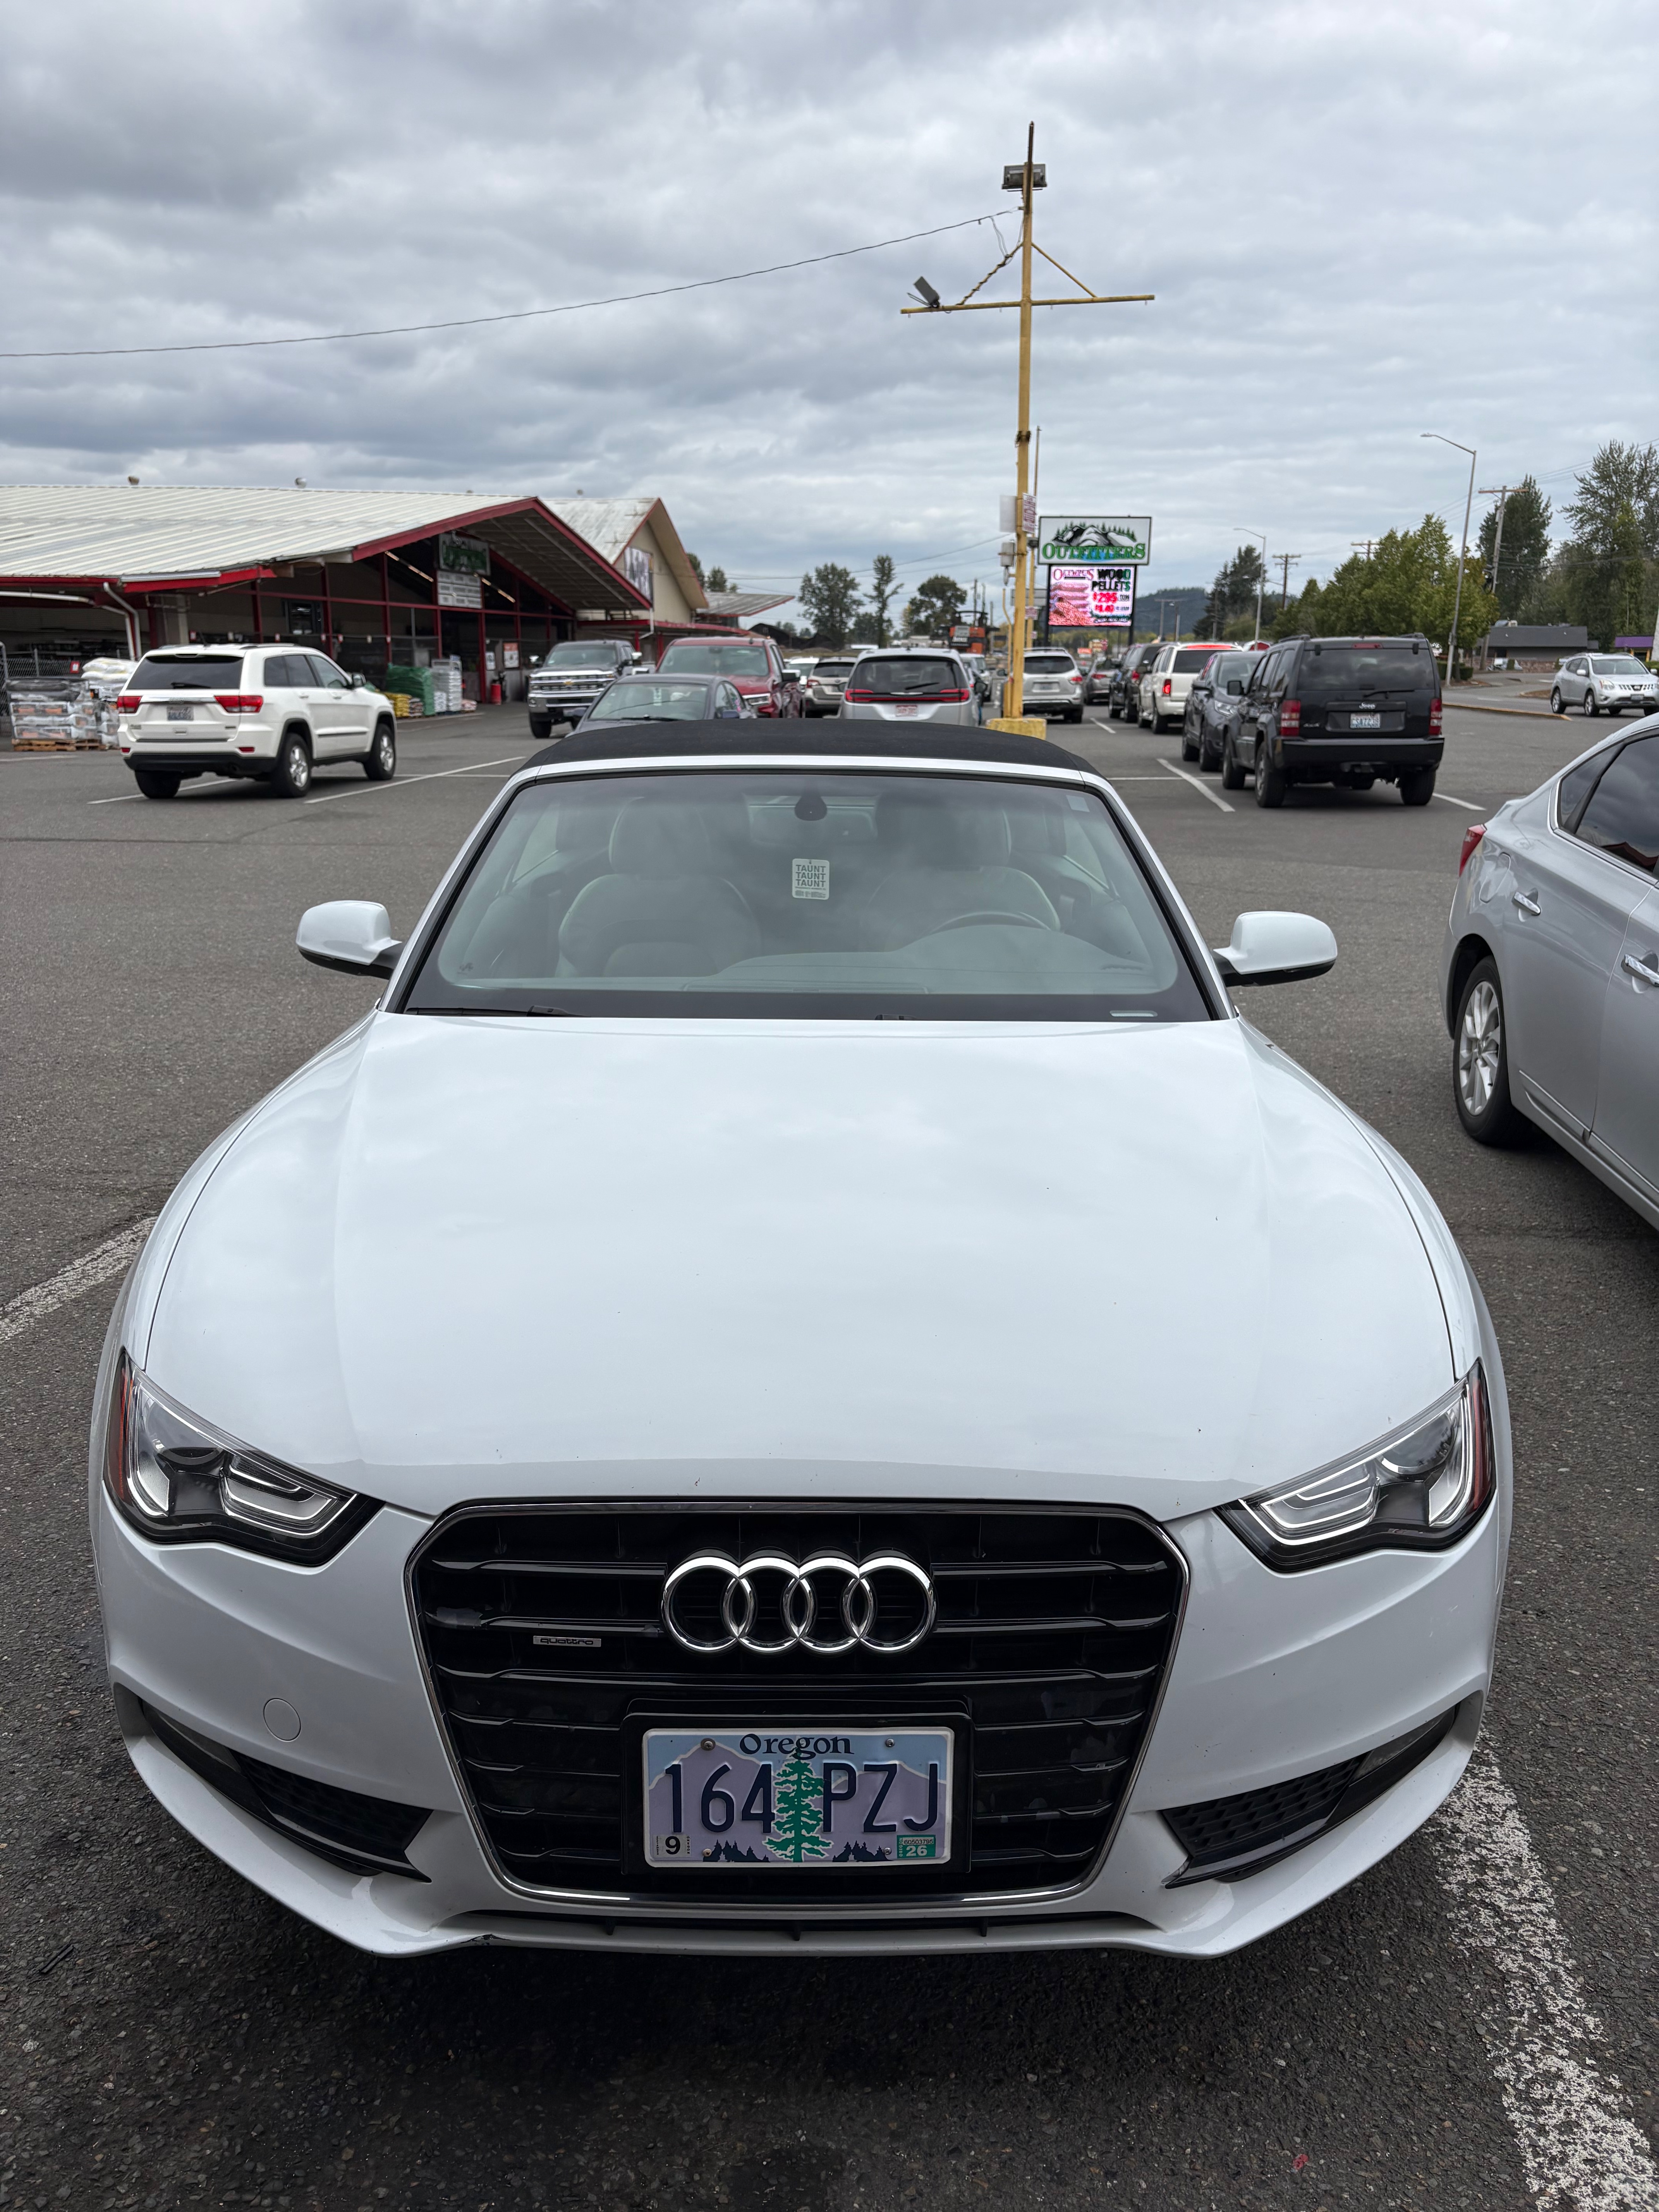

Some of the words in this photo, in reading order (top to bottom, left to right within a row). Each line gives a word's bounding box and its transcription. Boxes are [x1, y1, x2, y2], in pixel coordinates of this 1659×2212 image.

[1042, 543, 1145, 559] OUTFITTERS
[1097, 569, 1131, 580] WOOD
[1092, 581, 1131, 591] PELLETS
[796, 872, 826, 880] TAUNT
[795, 879, 826, 887] TAUNT
[740, 1734, 854, 1760] Oregon
[665, 1762, 774, 1833] 164
[823, 1762, 938, 1833] PZJ
[665, 1836, 680, 1855] 9
[906, 1845, 927, 1856] 26
